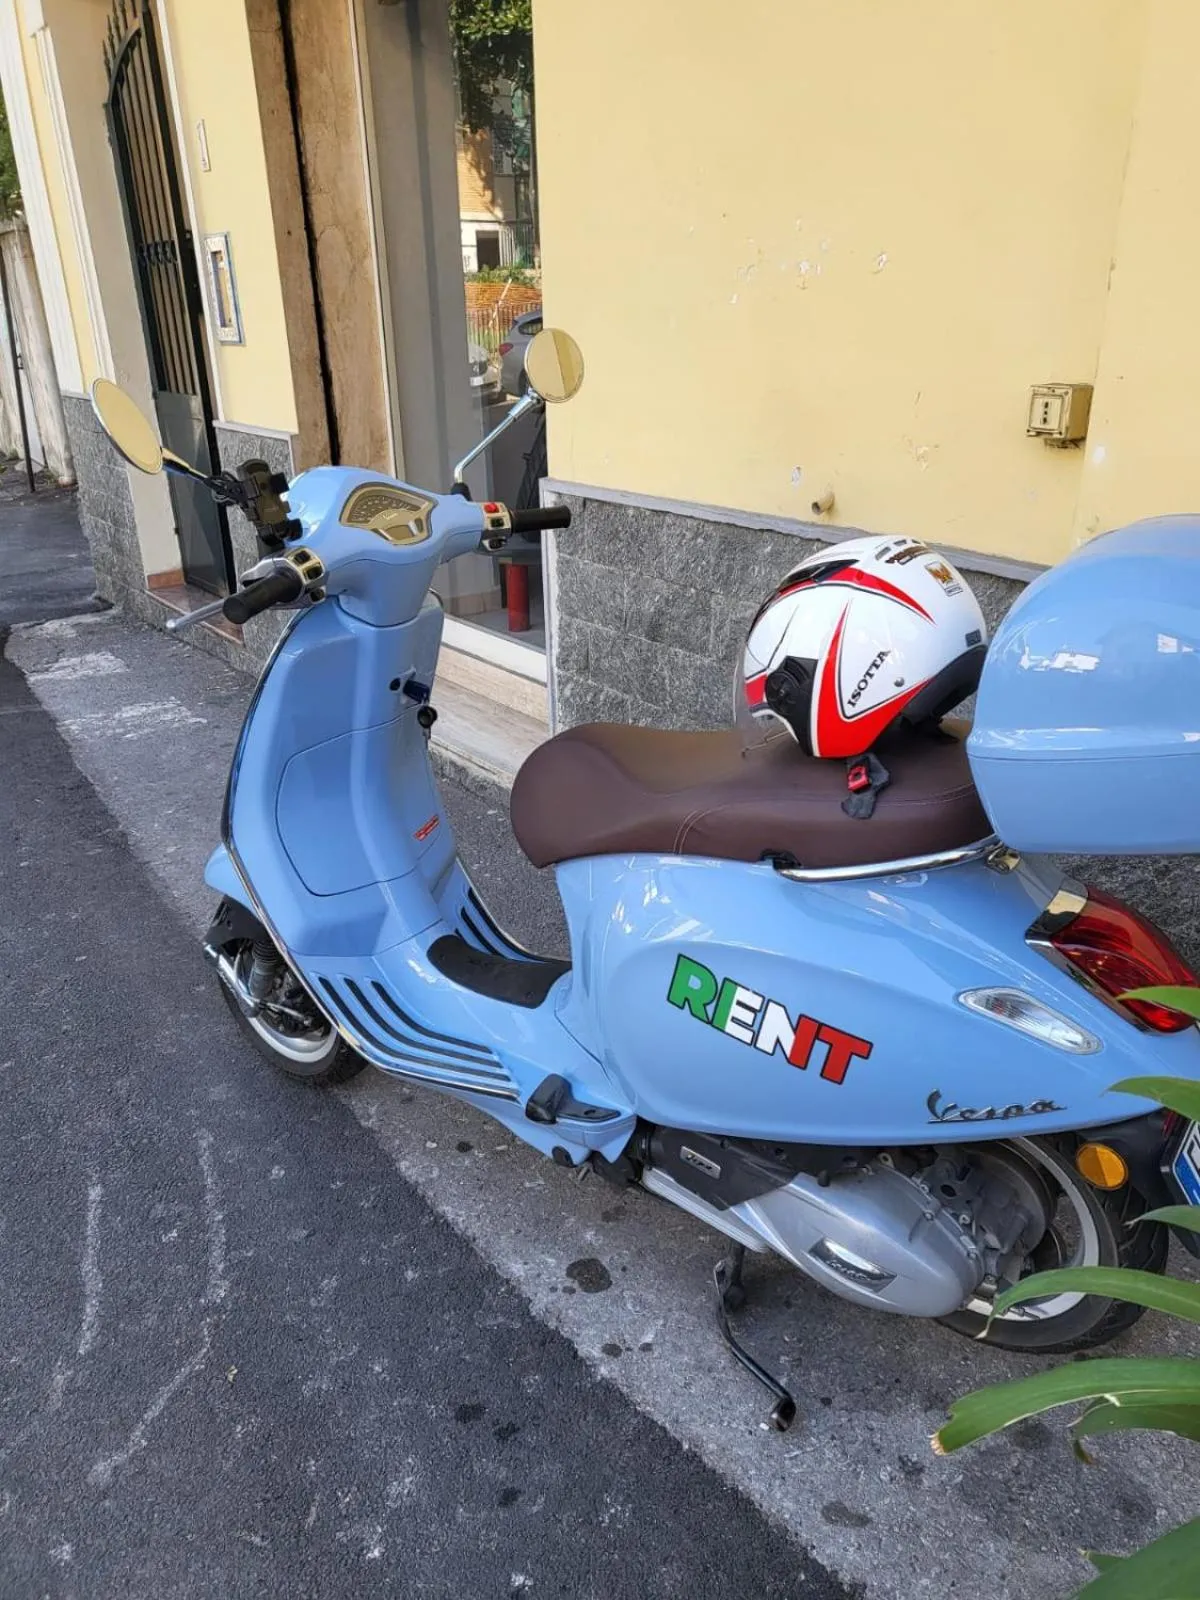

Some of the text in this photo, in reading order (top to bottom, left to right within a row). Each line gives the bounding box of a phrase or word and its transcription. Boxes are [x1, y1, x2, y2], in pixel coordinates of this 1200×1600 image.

[847, 650, 891, 708] ISOTTA
[667, 953, 873, 1085] RENT
[926, 1088, 1067, 1124] Vespa
